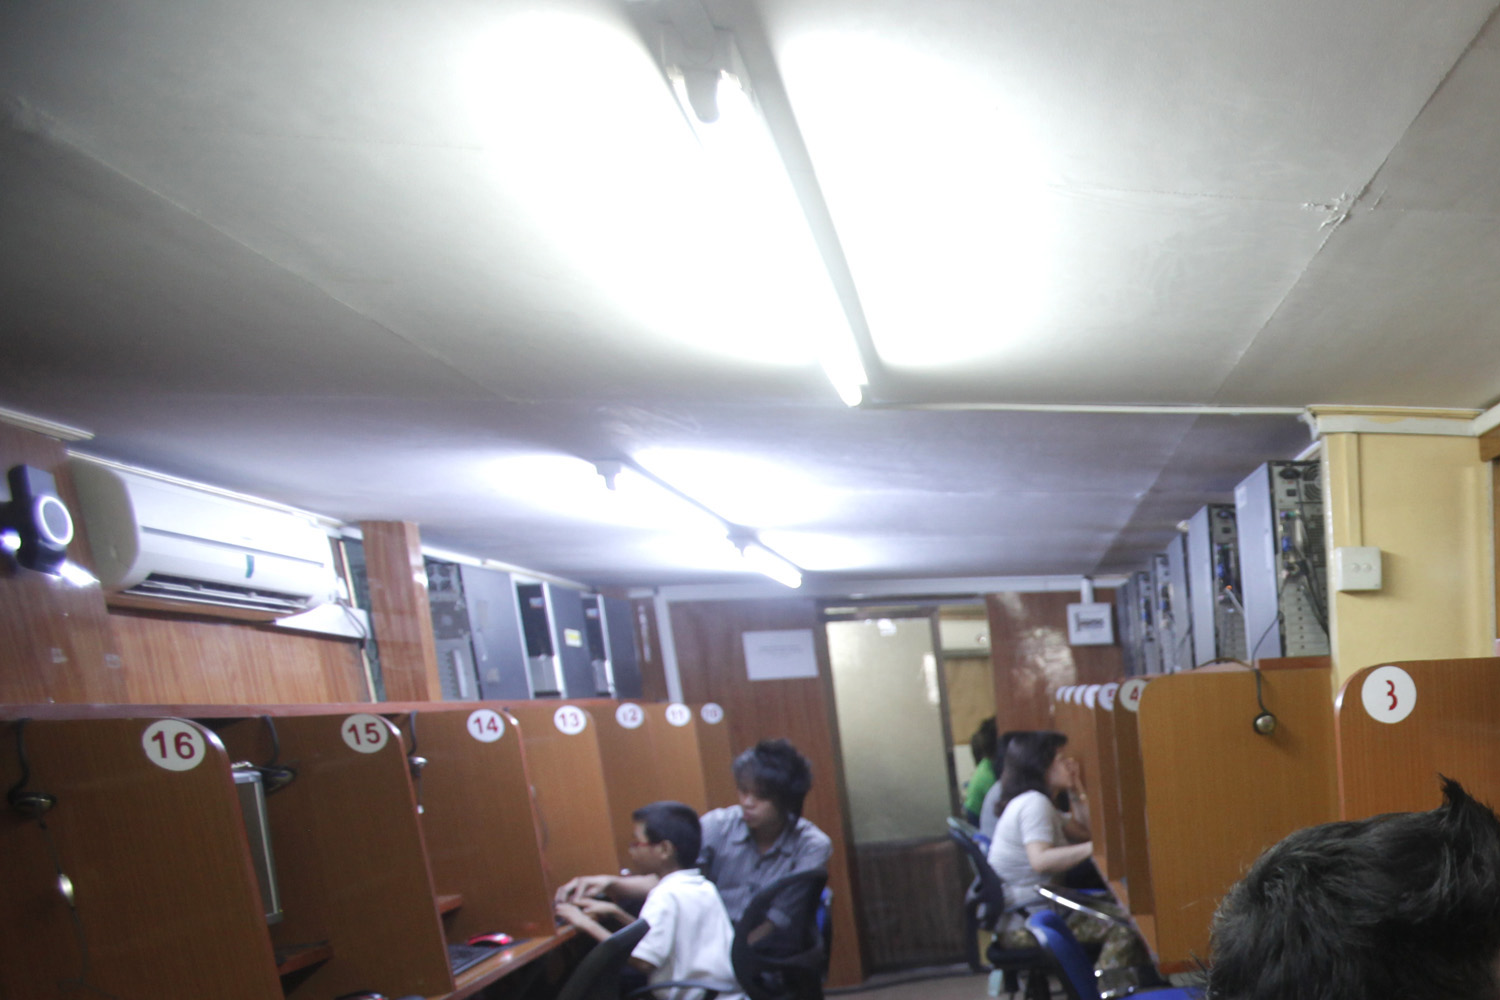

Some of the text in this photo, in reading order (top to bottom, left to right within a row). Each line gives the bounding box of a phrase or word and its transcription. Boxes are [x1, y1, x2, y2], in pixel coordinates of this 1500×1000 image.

[1385, 679, 1398, 711] 3
[473, 715, 499, 735] 14
[559, 712, 580, 728] 13
[622, 708, 638, 722] 12
[347, 721, 381, 746] 15
[151, 730, 196, 760] 16
